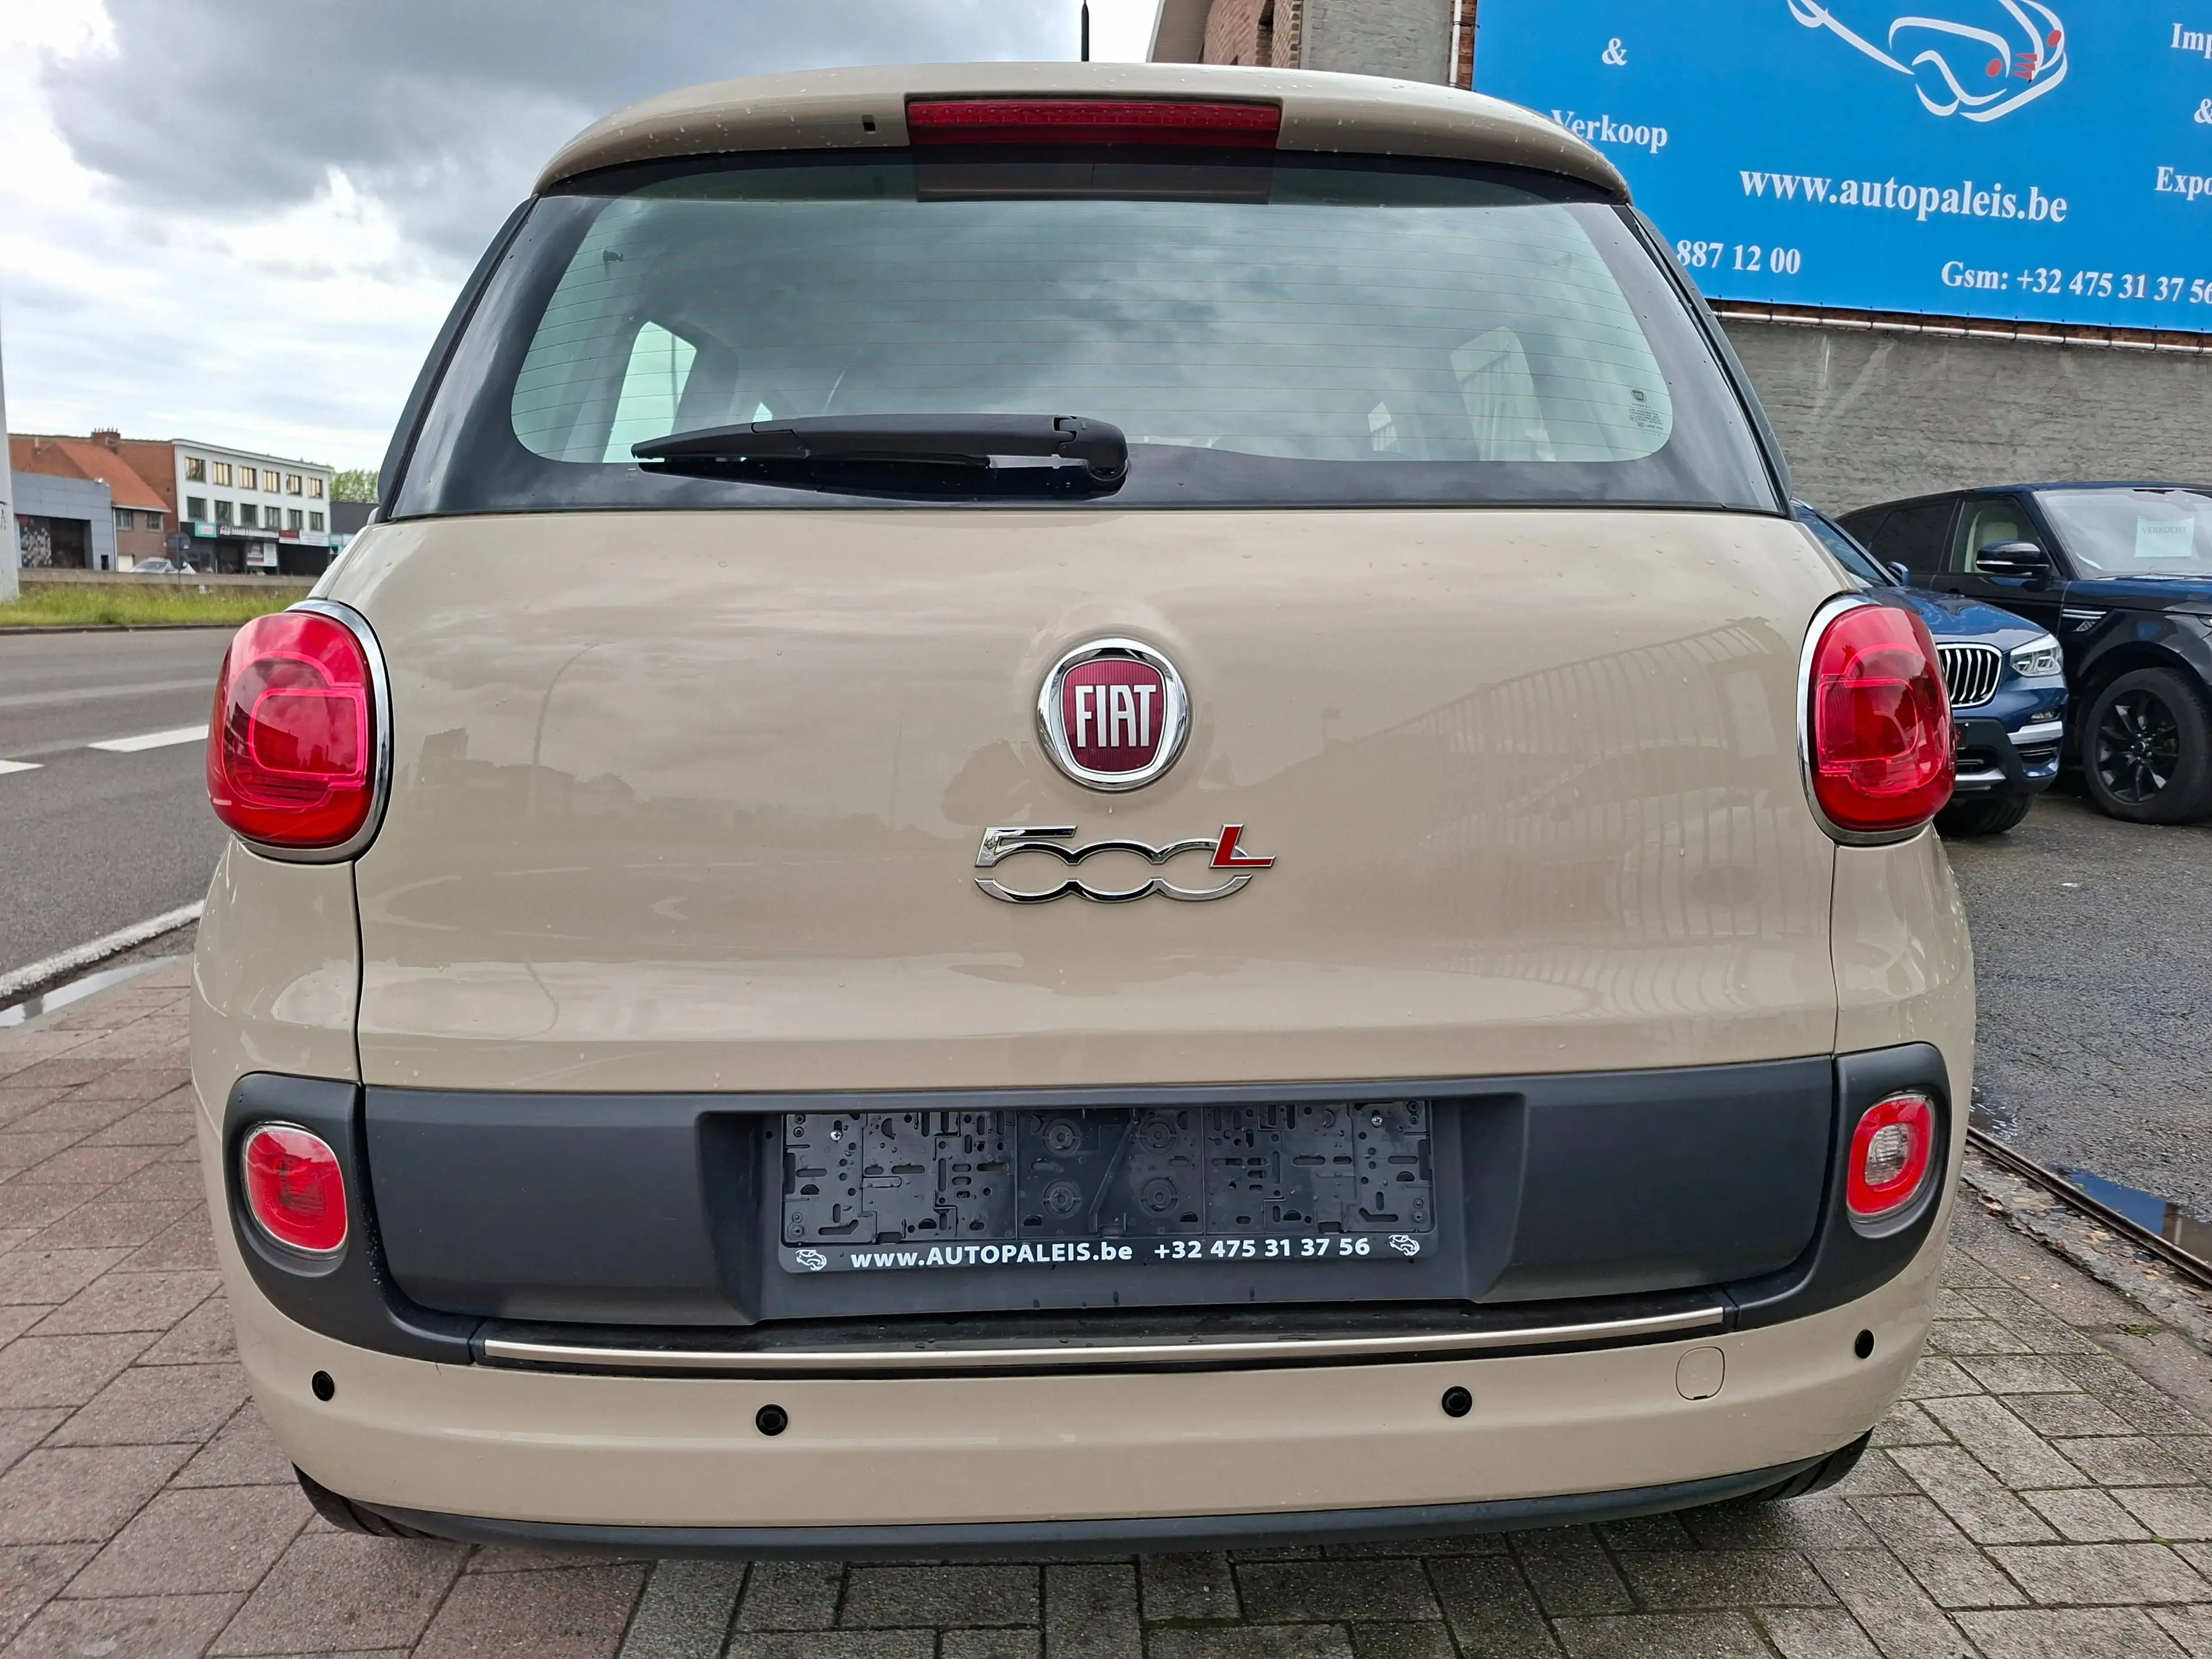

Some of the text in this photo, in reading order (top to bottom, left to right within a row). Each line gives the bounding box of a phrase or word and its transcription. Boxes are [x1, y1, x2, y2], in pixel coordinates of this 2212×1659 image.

[1602, 37, 1627, 66] &
[1551, 109, 1668, 154] Verkoop
[1738, 171, 2067, 222] www.autopaleis.be
[1677, 240, 1801, 274] 887 12 00
[1941, 260, 2009, 290] Gsm:
[2017, 267, 2062, 294] +32
[2069, 270, 2113, 297] 475
[2118, 274, 2146, 299] 31
[2153, 276, 2185, 302] 37
[2142, 526, 2188, 534] VERKOCHT
[1075, 684, 1157, 748] FIAT
[974, 823, 1276, 904] 500L
[850, 1237, 1370, 1268] www.AUTOPALEIS.be +32 475 31 37 56
